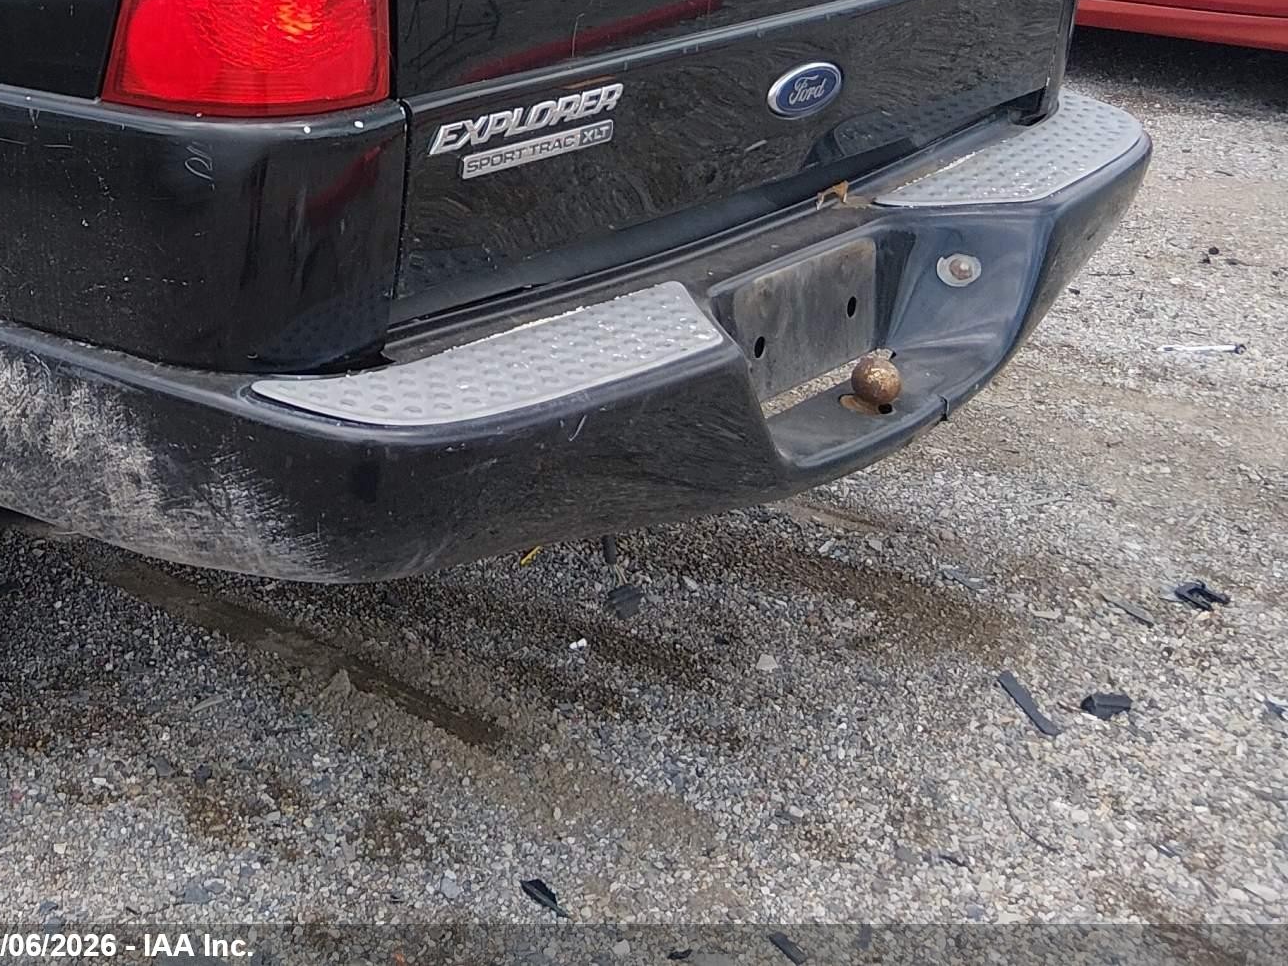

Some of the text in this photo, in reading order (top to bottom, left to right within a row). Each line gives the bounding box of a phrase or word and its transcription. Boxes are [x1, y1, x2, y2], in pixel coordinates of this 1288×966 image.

[788, 74, 827, 105] Ford
[428, 83, 624, 156] EXPLORER
[466, 125, 611, 174] SPORT TRAC XLT
